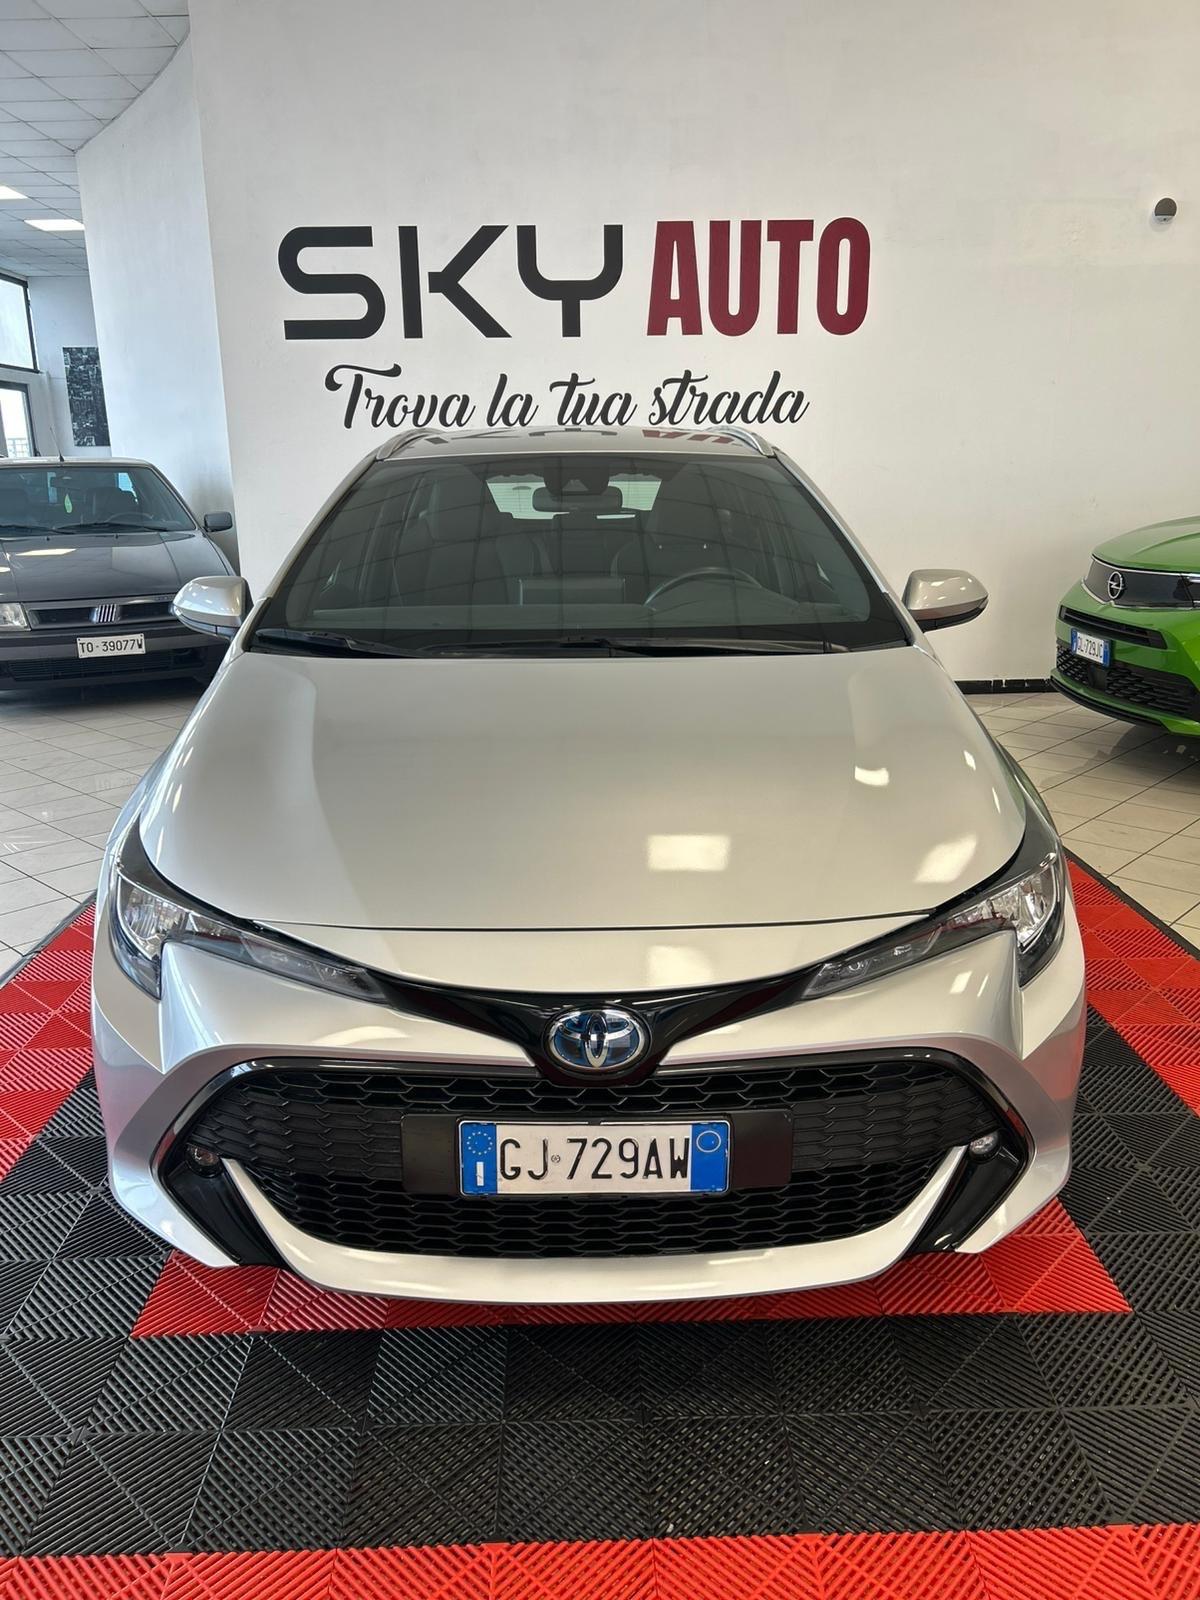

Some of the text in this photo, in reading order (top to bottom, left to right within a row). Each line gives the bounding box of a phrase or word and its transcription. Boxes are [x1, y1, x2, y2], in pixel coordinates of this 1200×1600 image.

[278, 217, 870, 340] SKY AUTO
[325, 363, 810, 429] Trova la tua strada
[500, 1137, 690, 1180] GJ 729AW
